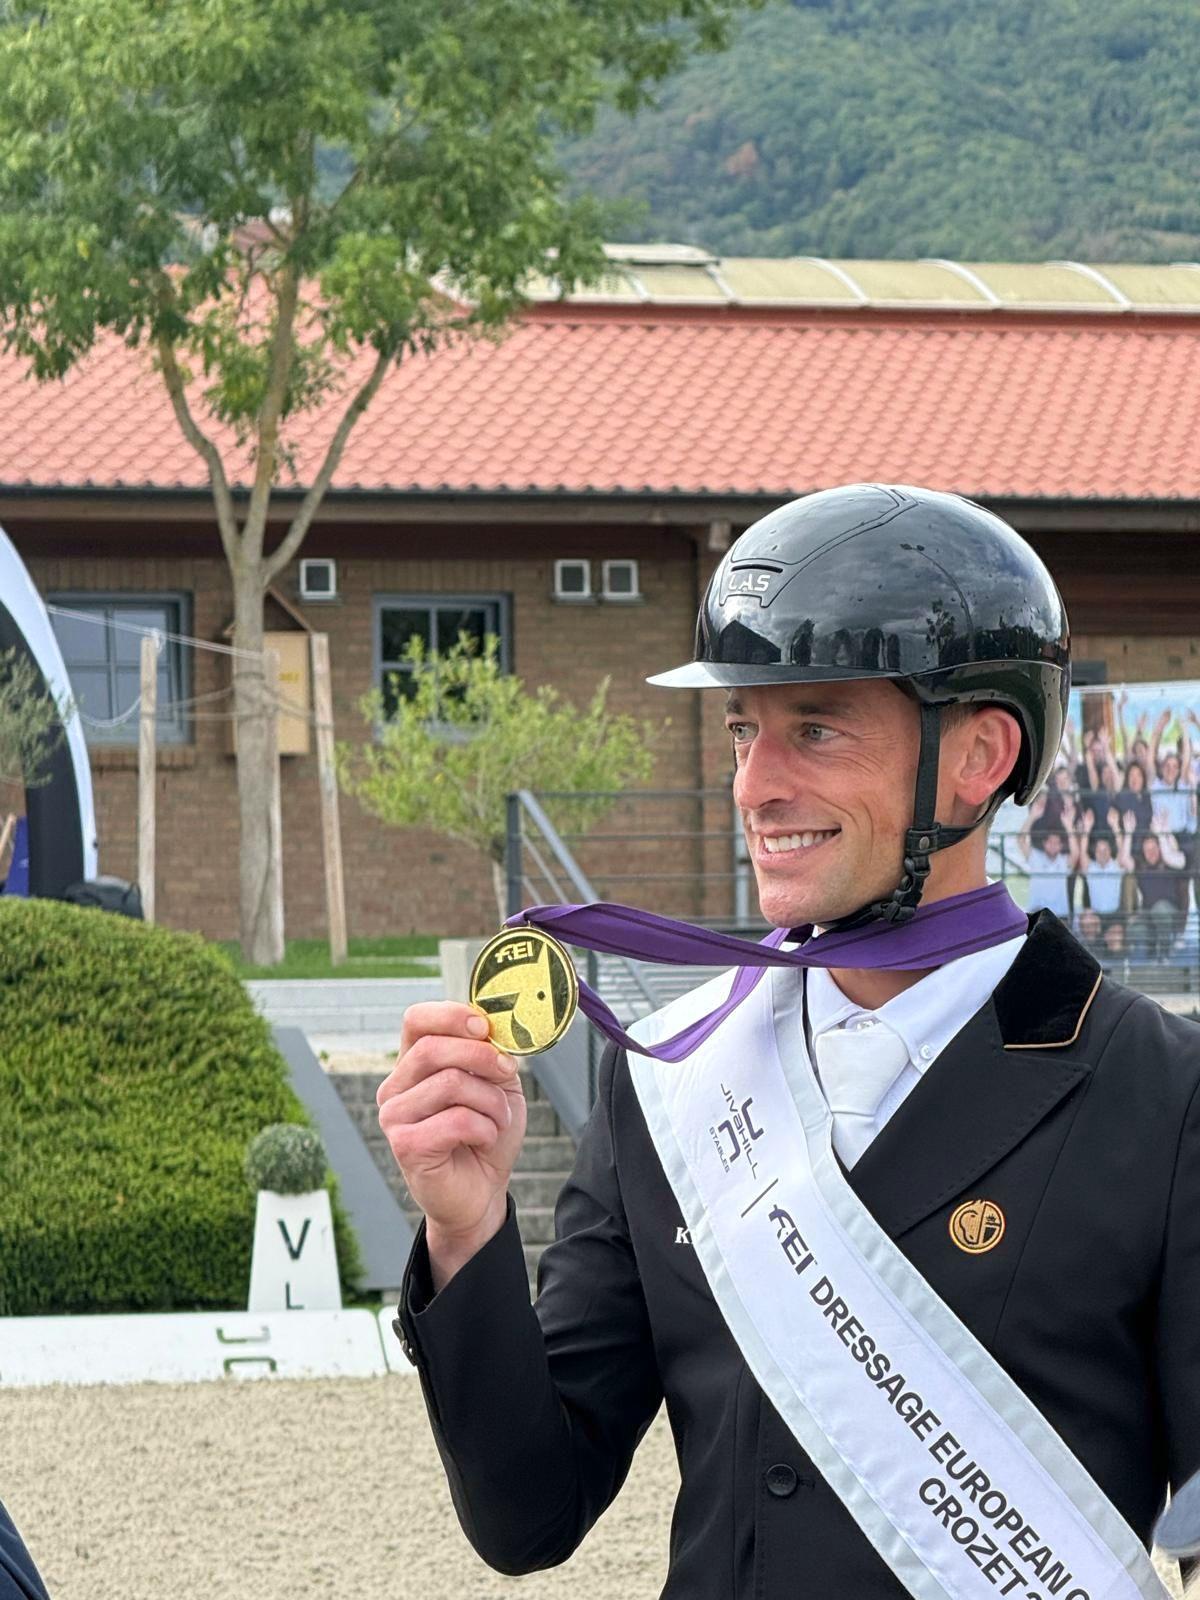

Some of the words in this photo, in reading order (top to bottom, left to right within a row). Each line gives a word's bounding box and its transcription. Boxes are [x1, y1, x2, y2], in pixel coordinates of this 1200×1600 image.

[495, 940, 534, 964] FEI
[709, 1126, 730, 1174] STABLES
[277, 1218, 311, 1261] V
[286, 1281, 304, 1310] L
[768, 1204, 816, 1276] FEI
[809, 1275, 942, 1442] DRESSAGE
[928, 1431, 1073, 1596] EUROPEAN
[918, 1477, 1029, 1596] CROZET
